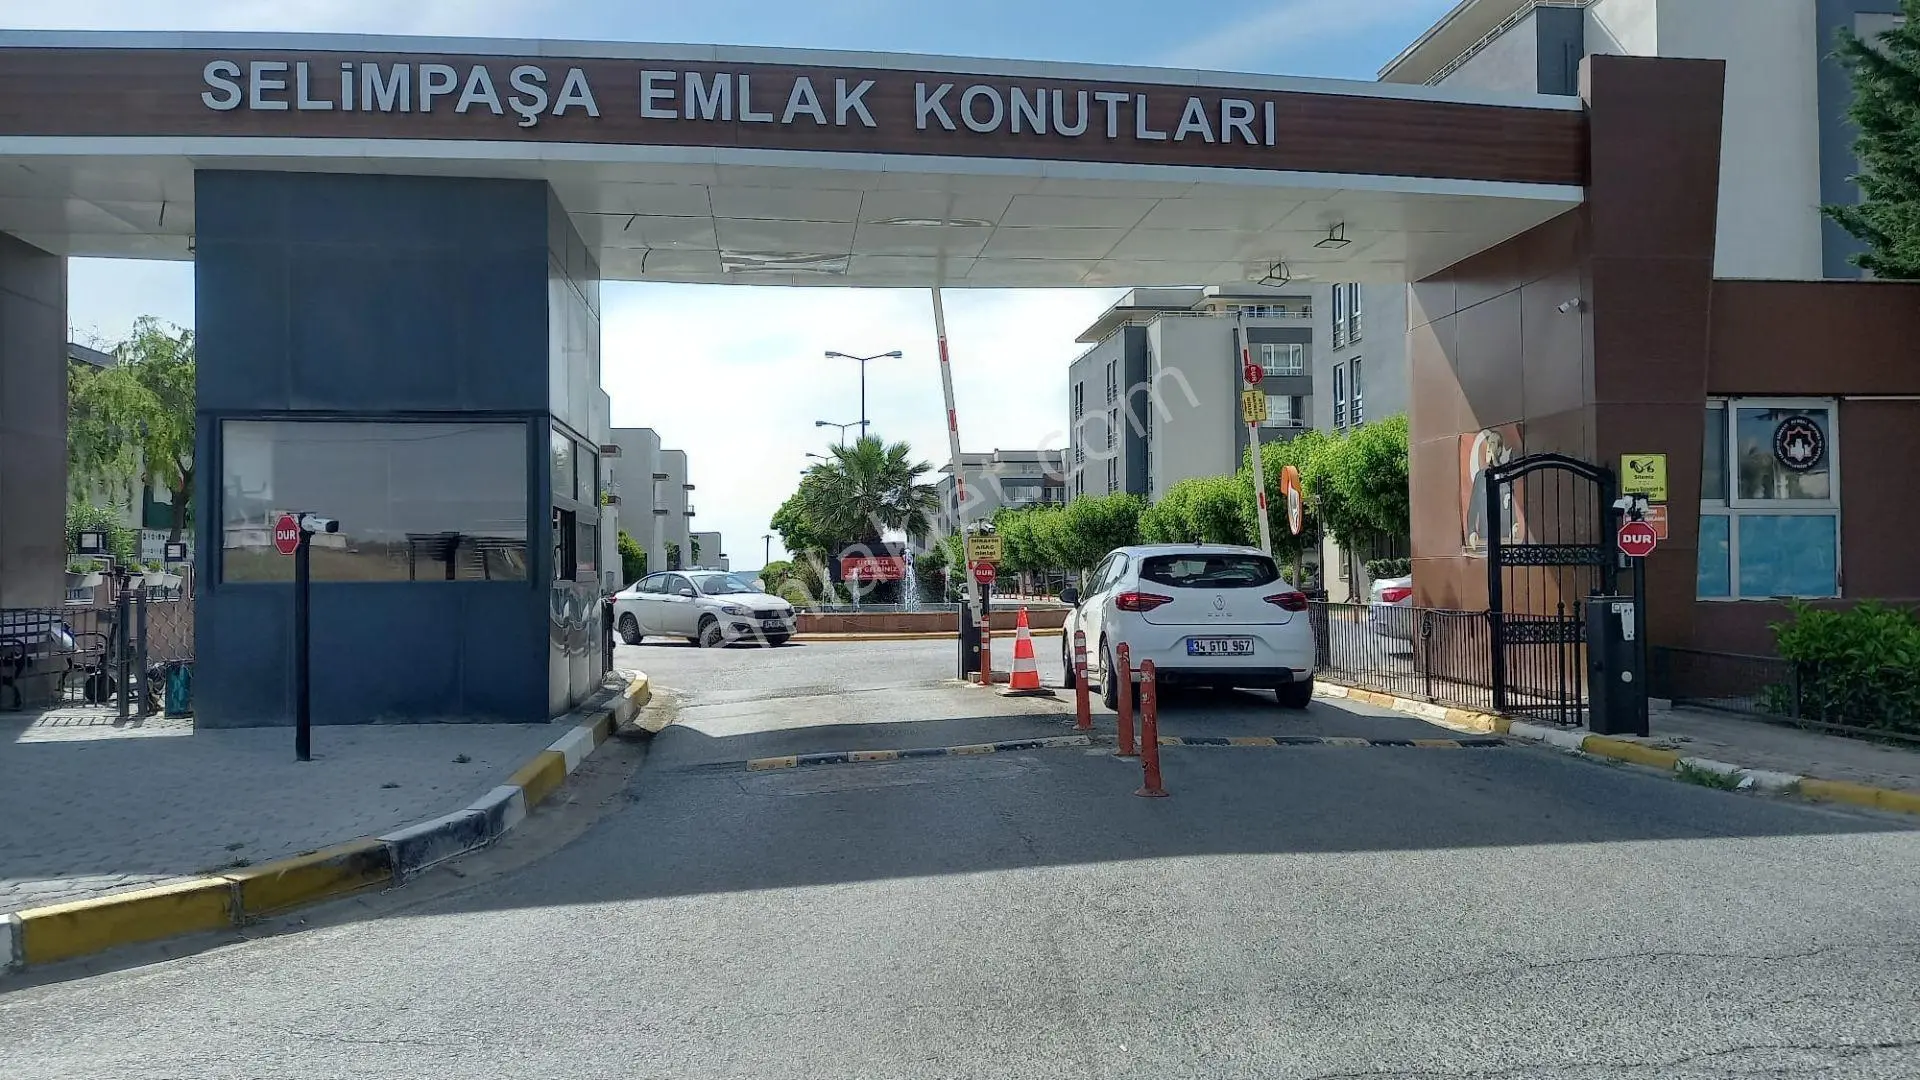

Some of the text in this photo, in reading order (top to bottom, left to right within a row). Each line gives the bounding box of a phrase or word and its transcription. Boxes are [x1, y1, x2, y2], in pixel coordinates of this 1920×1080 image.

[201, 60, 1276, 147] SELİMPAŞA EMLAK KONUTLARI
[277, 529, 296, 540] DUR
[1622, 534, 1652, 544] DUR
[1194, 640, 1206, 652] 34
[1232, 640, 1251, 651] 967
